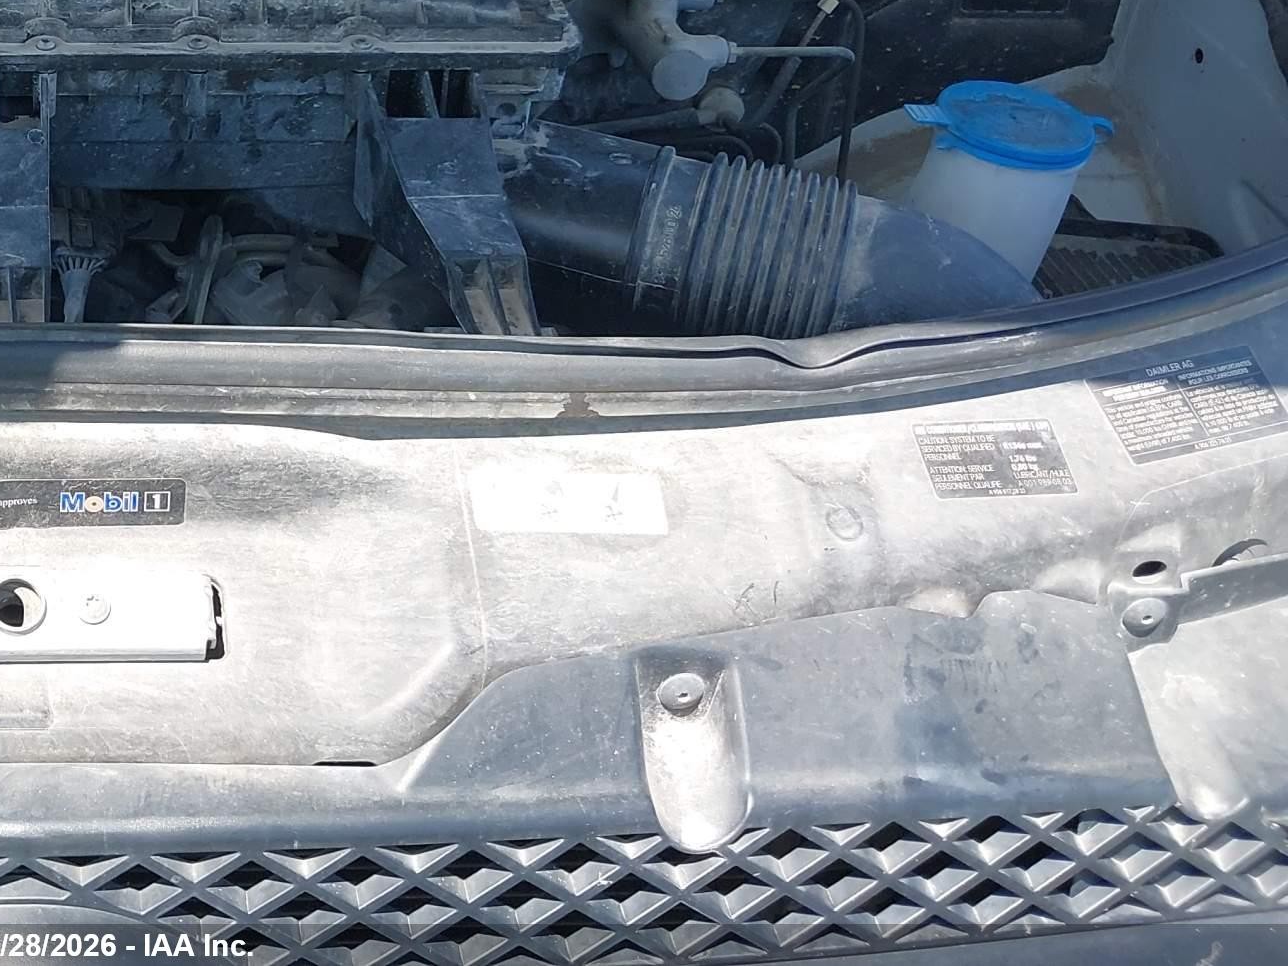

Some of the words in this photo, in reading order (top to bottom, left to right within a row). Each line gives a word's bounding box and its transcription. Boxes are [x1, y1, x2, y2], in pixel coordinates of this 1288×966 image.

[1145, 363, 1181, 376] DAIMLER
[1180, 360, 1195, 368] AG
[921, 445, 954, 453] SERVICED
[967, 464, 995, 472] SERVICE
[59, 491, 139, 513] Mobil
